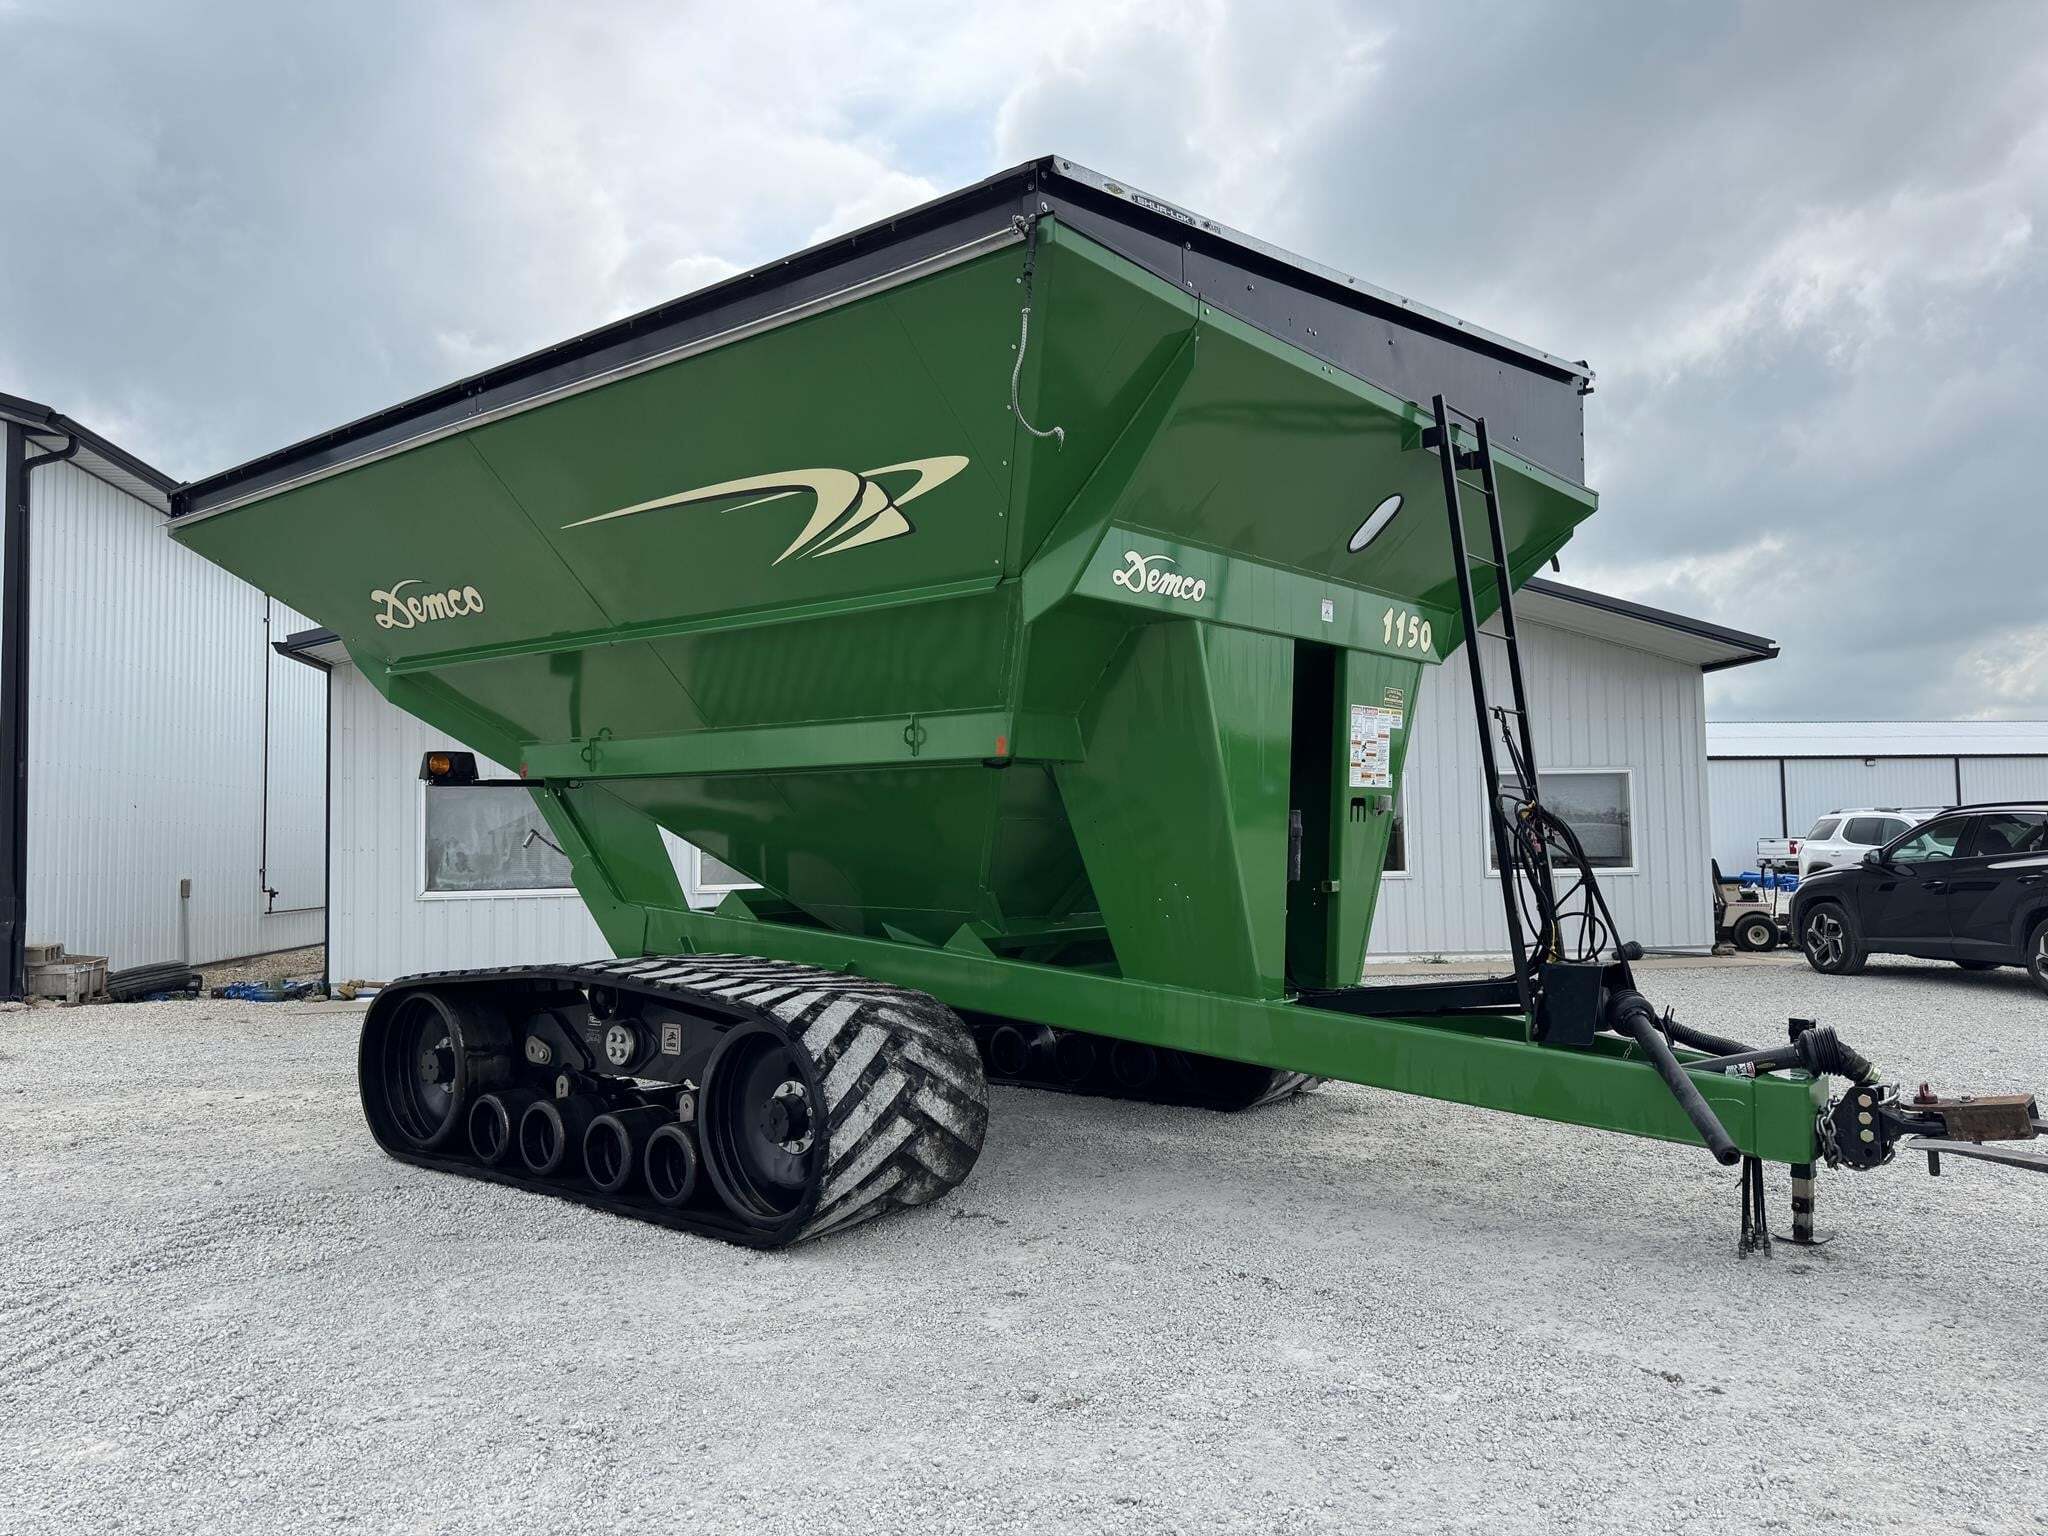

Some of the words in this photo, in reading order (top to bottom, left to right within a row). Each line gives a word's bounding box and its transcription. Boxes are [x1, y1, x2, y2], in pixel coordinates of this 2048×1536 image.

[1112, 550, 1206, 602] Demco
[370, 579, 484, 629] Demco
[1383, 607, 1432, 653] 1150
